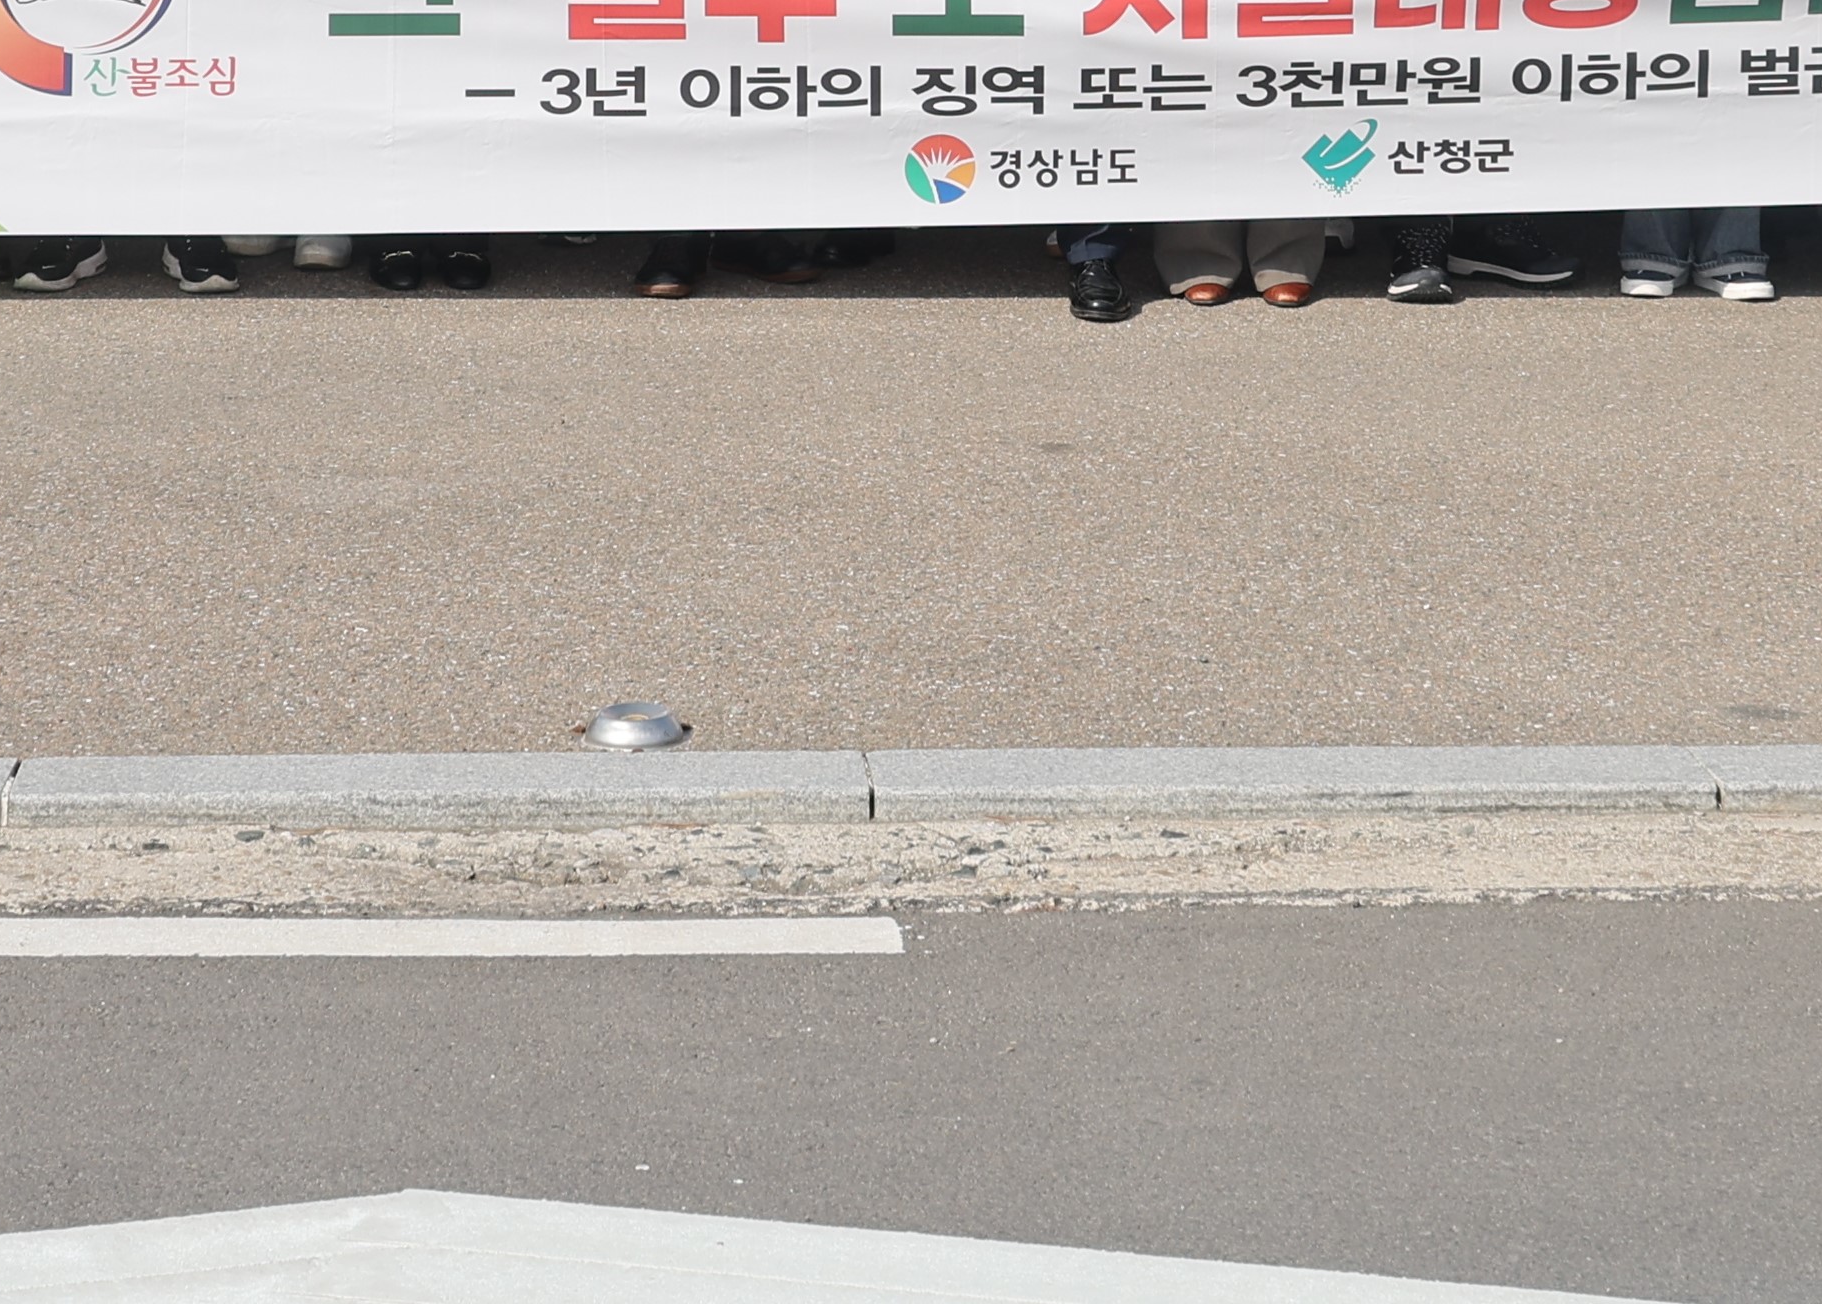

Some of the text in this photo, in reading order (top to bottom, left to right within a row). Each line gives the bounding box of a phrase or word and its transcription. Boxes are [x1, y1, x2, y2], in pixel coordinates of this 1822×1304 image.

[83, 56, 236, 97] 산불조심
[540, 65, 646, 117] 3년
[680, 65, 882, 117] 이하의
[911, 65, 1045, 117] 징역
[1073, 64, 1213, 112] 또는
[1236, 56, 1481, 108] 3천만원
[1511, 49, 1710, 102] 이하의
[990, 148, 1138, 189] 경상남도
[1387, 139, 1515, 175] 산청군
